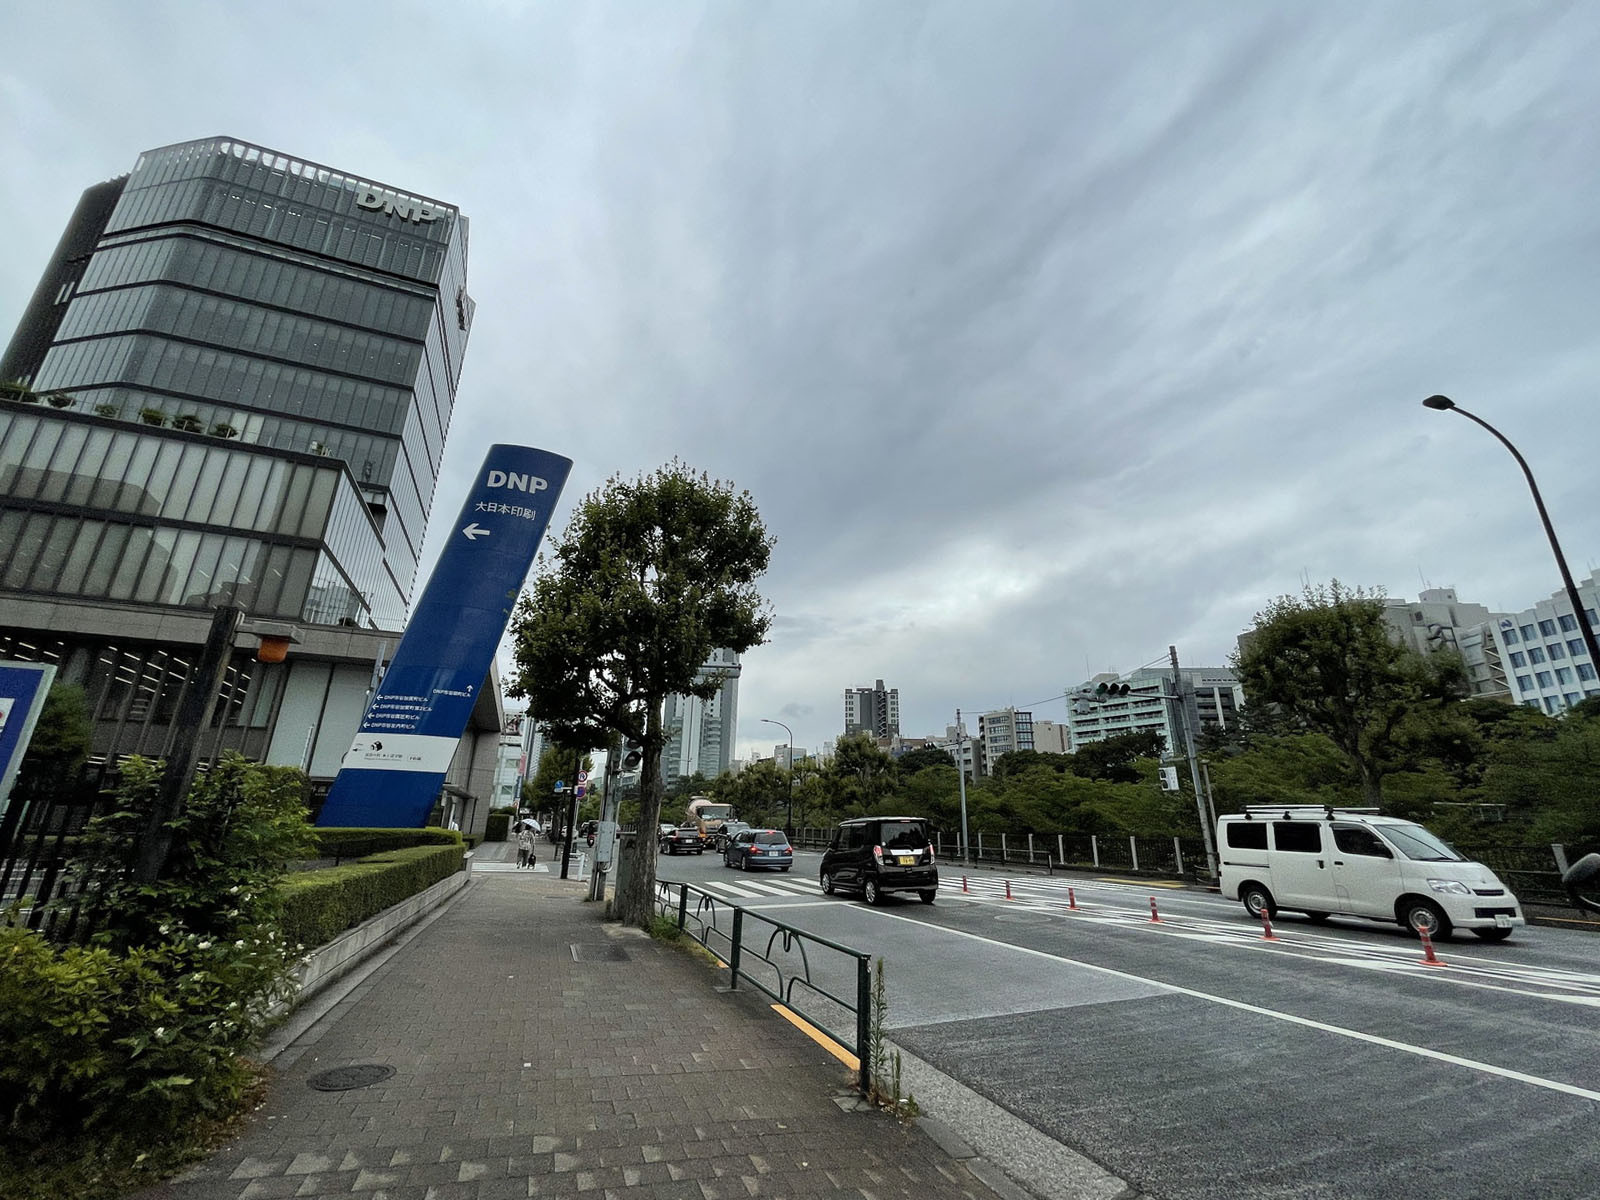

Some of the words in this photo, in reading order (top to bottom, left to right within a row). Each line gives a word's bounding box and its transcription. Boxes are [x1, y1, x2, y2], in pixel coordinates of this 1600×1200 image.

[356, 190, 439, 223] DNP
[487, 470, 548, 494] DNP
[475, 501, 536, 520] 大日本印刷
